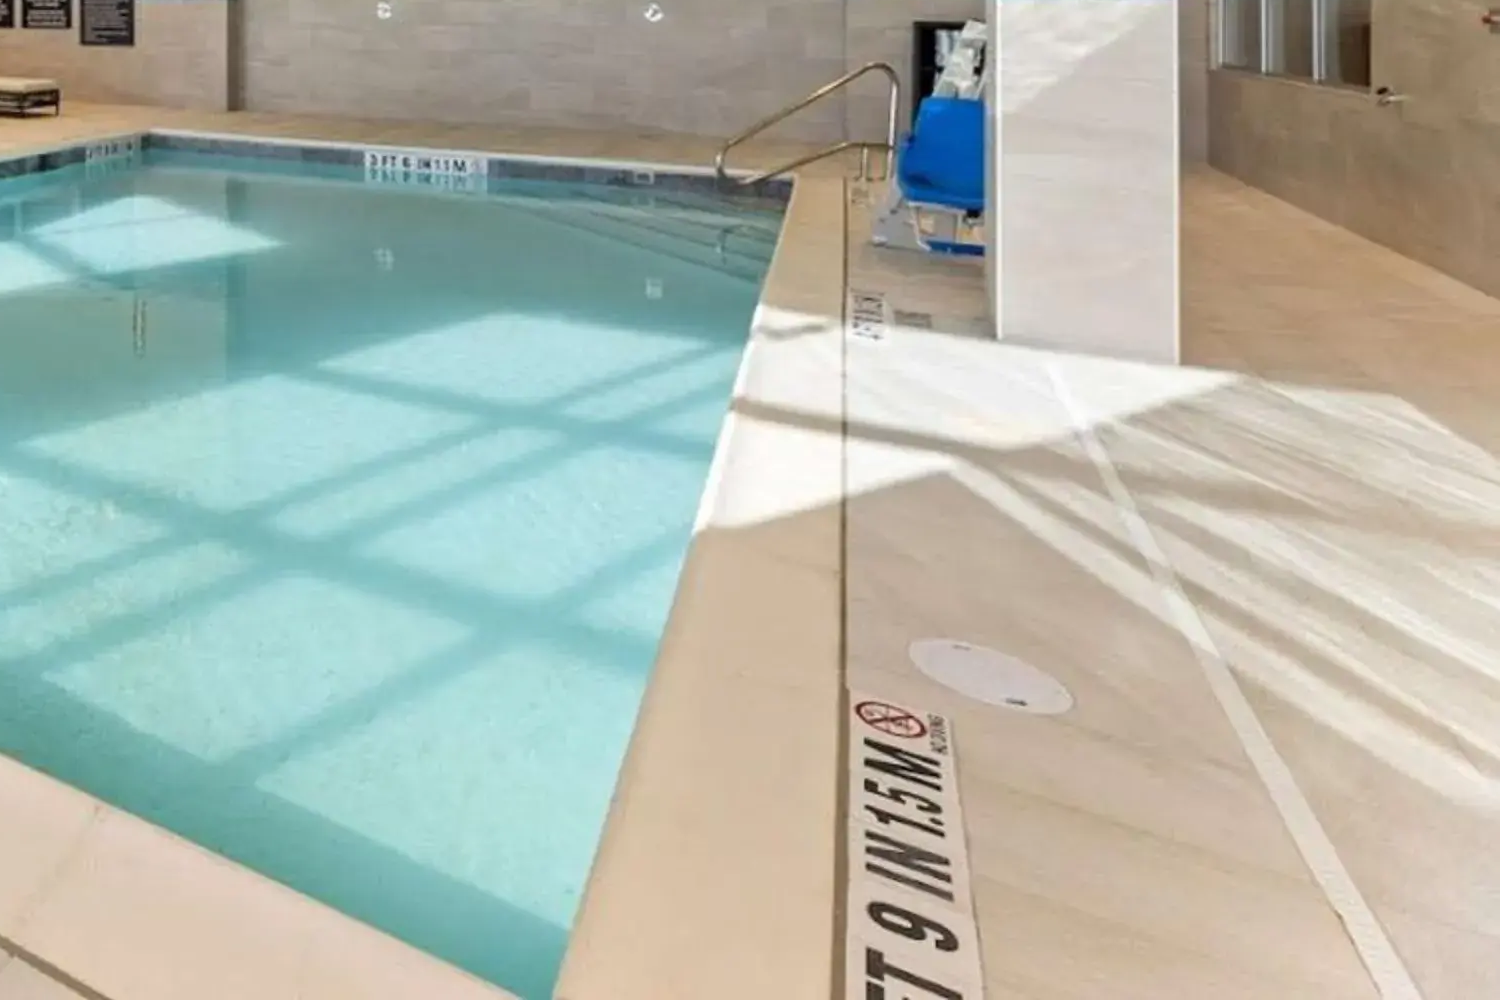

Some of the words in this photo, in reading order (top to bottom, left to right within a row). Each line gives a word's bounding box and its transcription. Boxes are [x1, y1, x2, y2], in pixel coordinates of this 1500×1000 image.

[381, 155, 396, 167] FT
[453, 159, 467, 173] M
[863, 736, 943, 792] M
[863, 778, 946, 838] 1.5
[864, 830, 955, 903] IN
[866, 901, 960, 952] 9
